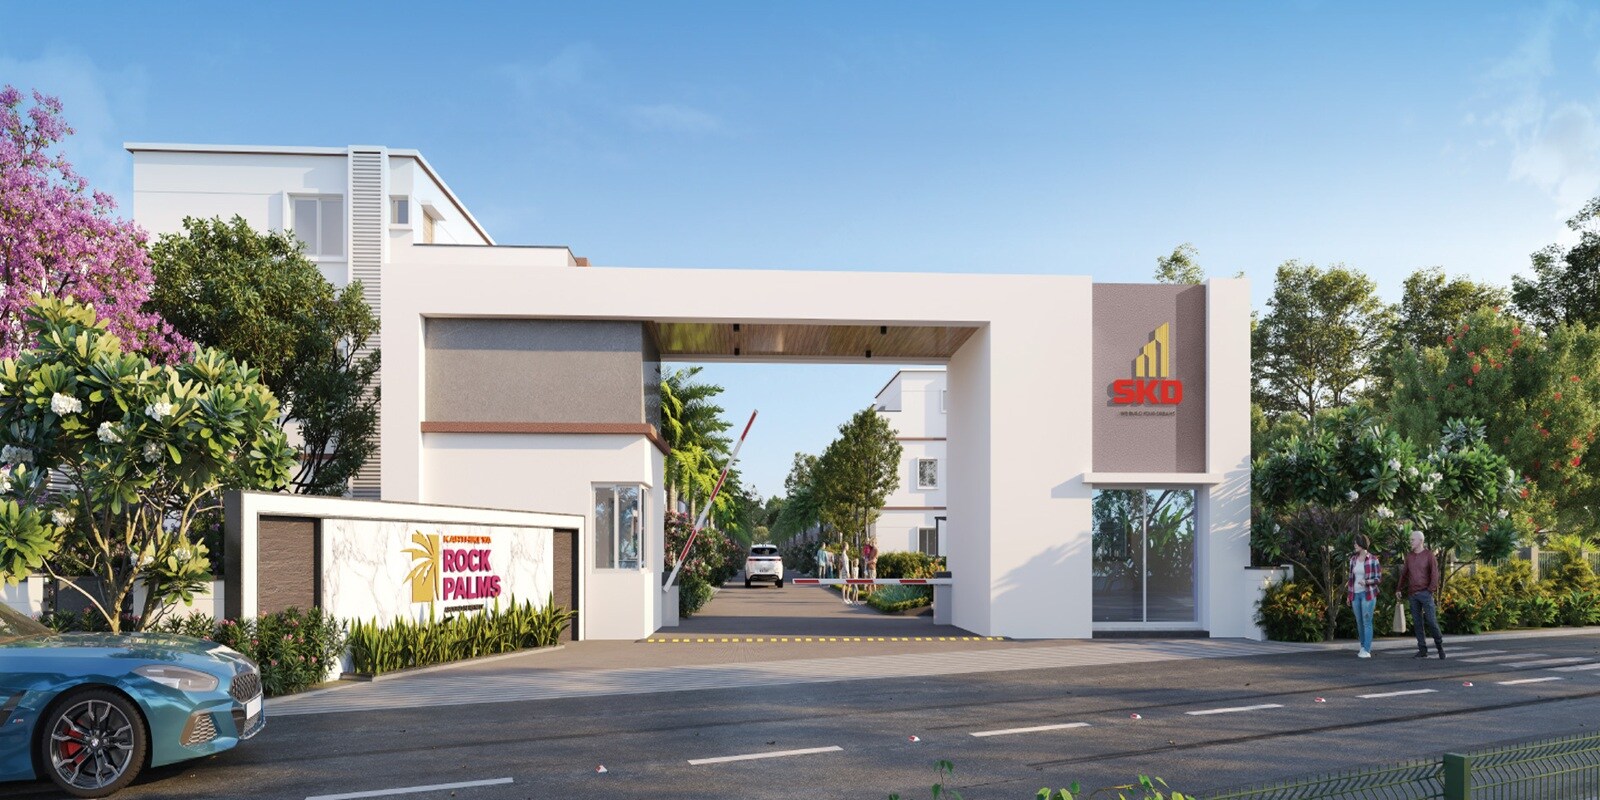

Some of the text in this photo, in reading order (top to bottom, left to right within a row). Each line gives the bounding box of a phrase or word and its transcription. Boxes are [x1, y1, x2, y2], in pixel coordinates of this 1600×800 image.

[1112, 379, 1184, 405] SKD
[443, 549, 492, 573] ROCK
[443, 575, 502, 601] PALMS
